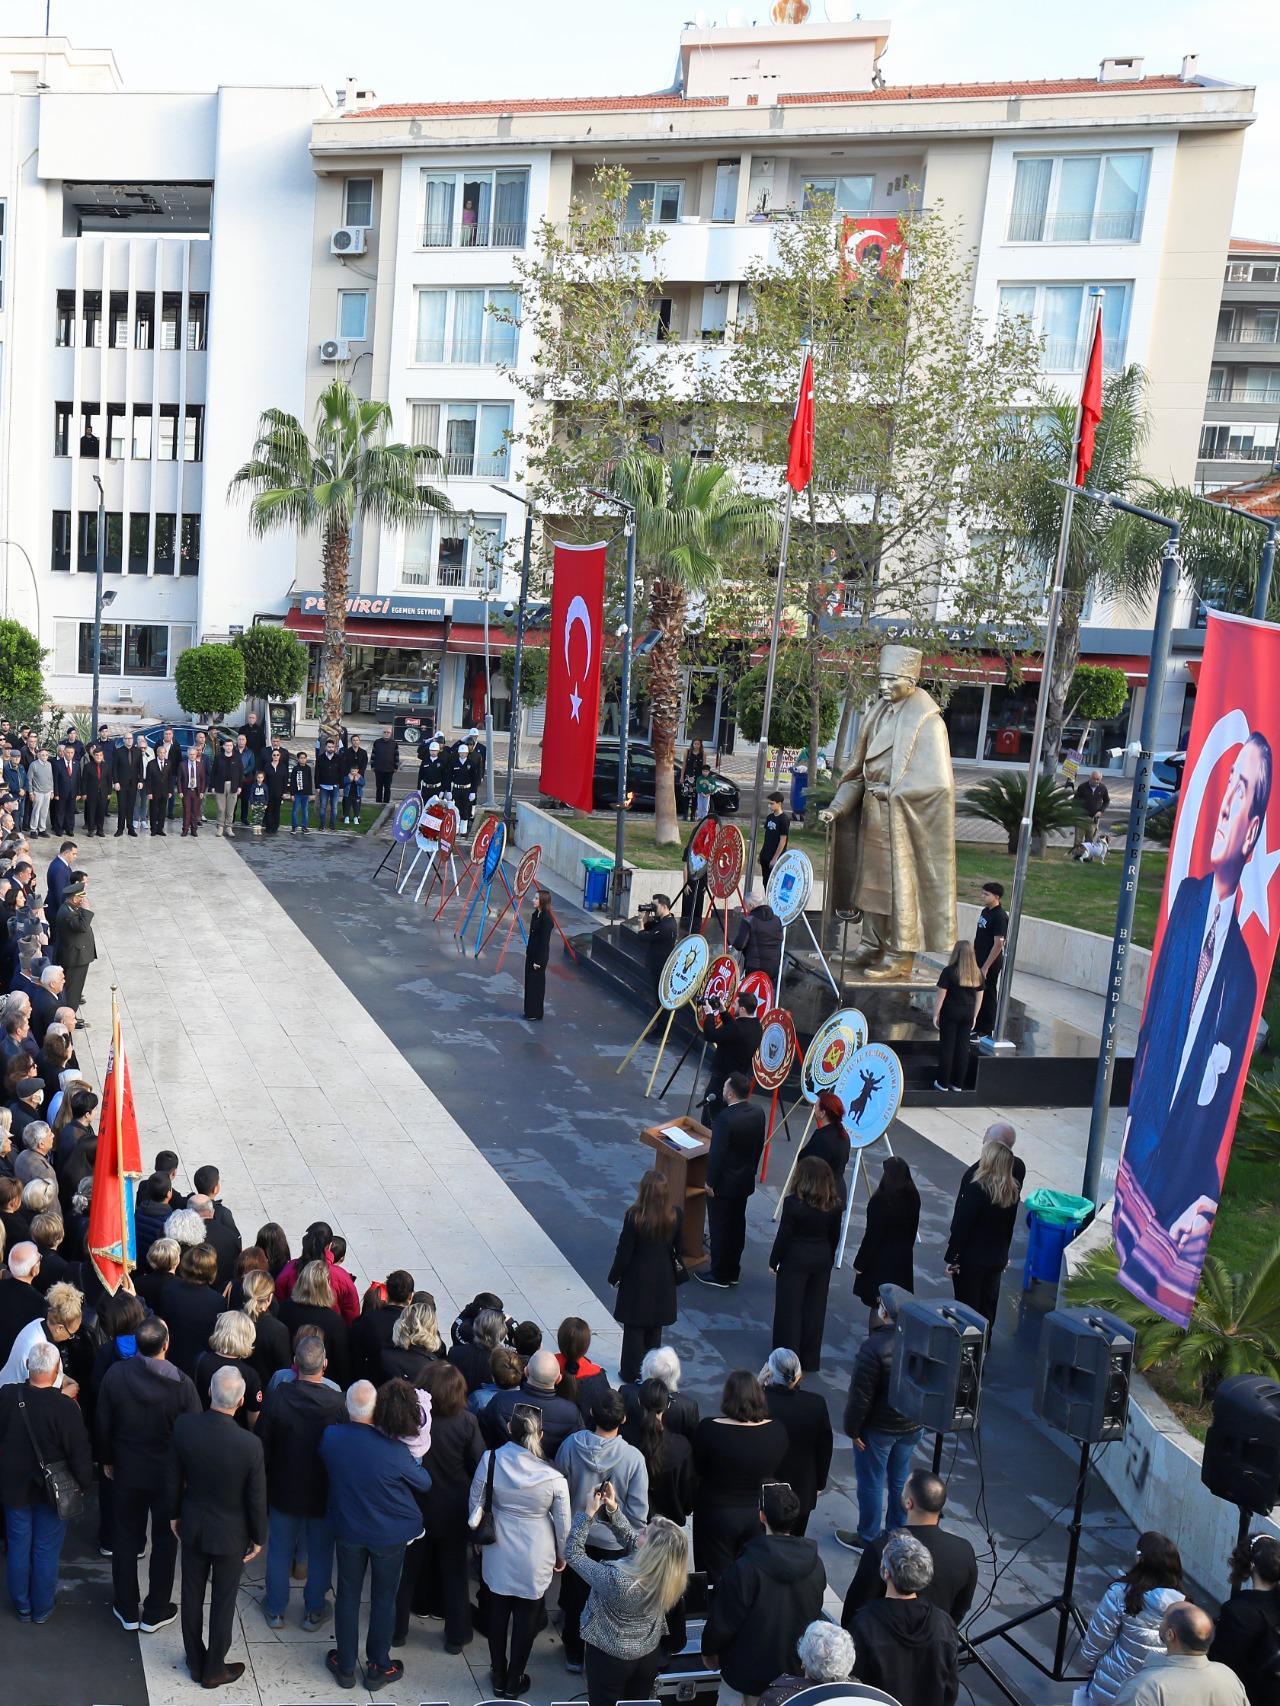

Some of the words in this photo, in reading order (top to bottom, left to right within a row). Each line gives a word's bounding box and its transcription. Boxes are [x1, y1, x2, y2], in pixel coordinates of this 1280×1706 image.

[391, 606, 417, 614] EGEMEN
[417, 608, 441, 616] SEYMEN
[1103, 928, 1128, 1081] BELEDİYESİ
